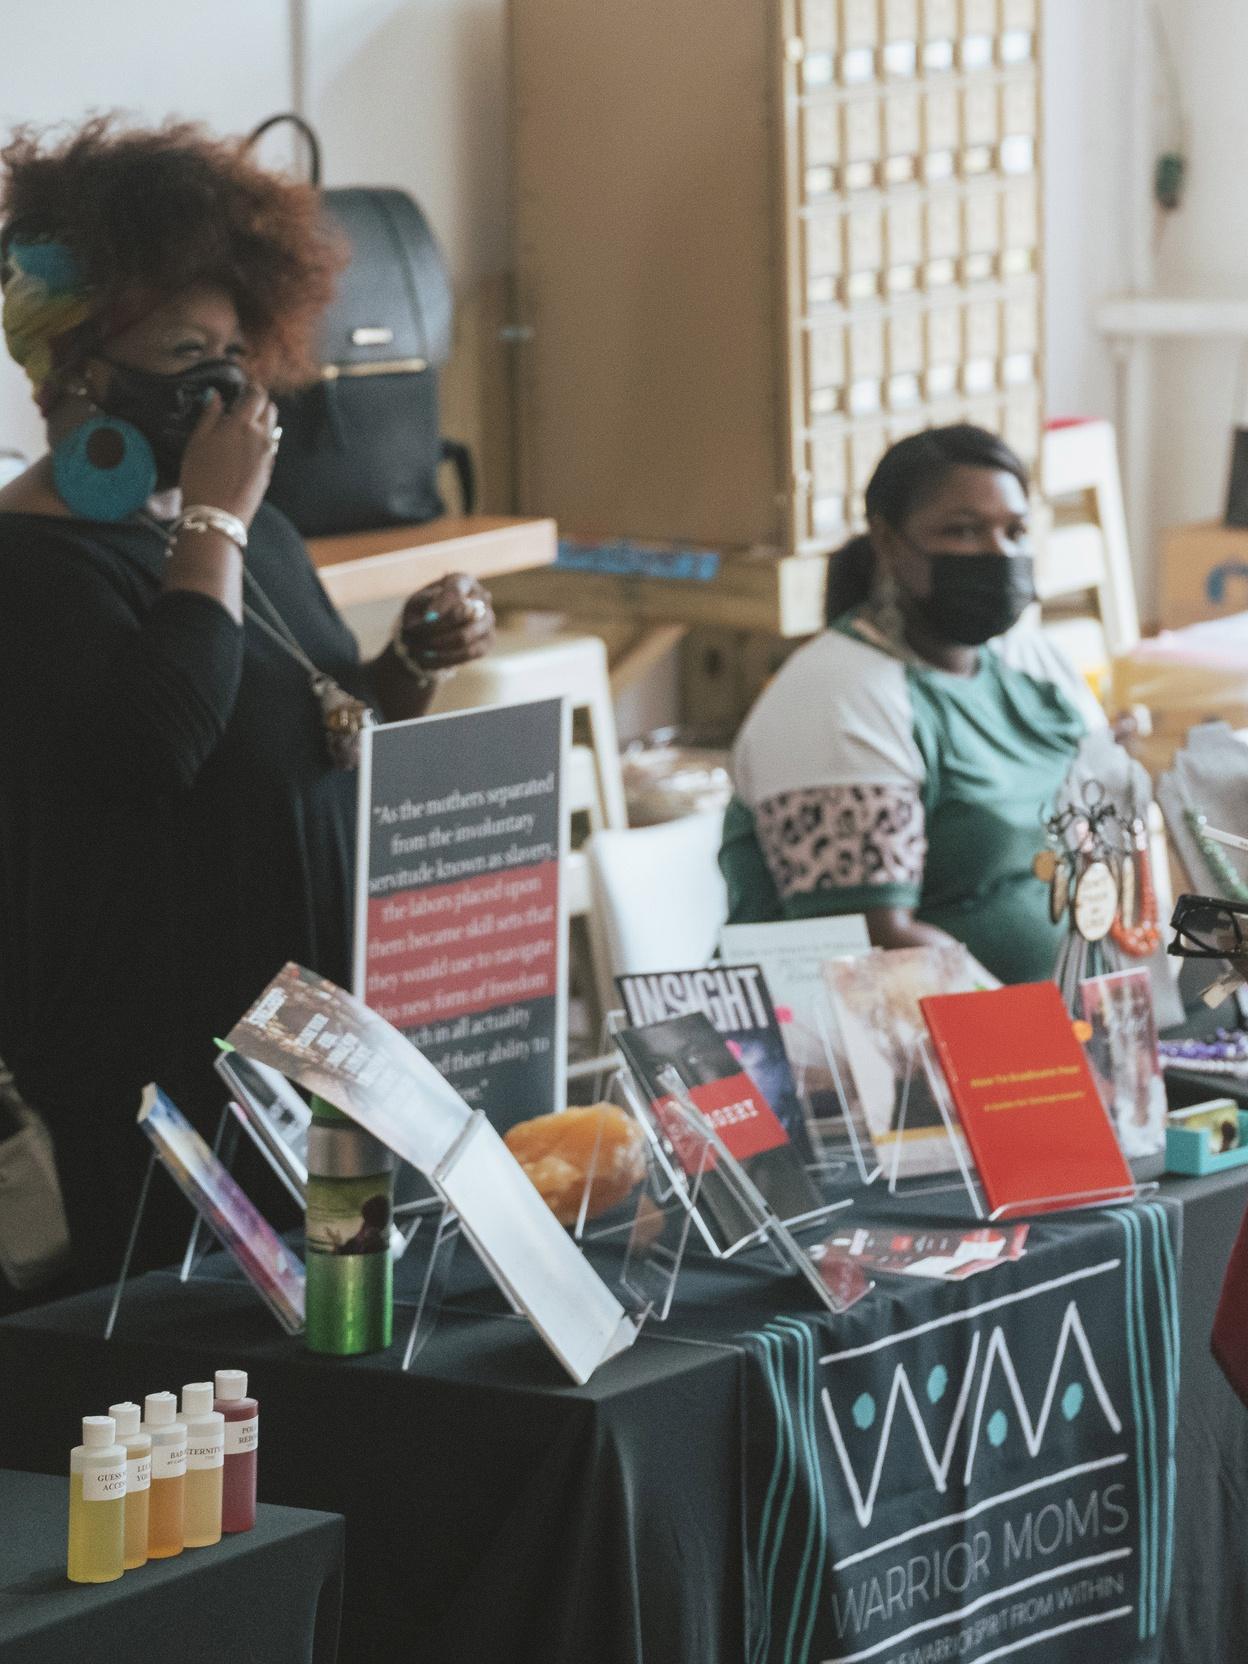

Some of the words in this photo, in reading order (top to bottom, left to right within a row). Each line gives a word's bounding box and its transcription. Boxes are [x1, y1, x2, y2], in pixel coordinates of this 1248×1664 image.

[400, 799, 424, 821] the
[425, 789, 485, 815] mothers
[486, 771, 555, 808] separated
[391, 833, 427, 855] from
[428, 826, 452, 848] the
[453, 813, 535, 844] involuntary
[367, 861, 434, 893] servitude
[435, 858, 486, 880] known
[488, 852, 503, 869] as
[381, 902, 405, 924] the
[408, 894, 451, 918] labors
[453, 878, 502, 913] placed
[503, 877, 542, 903] upon
[367, 936, 405, 958] them
[407, 925, 464, 950] became
[465, 912, 495, 938] skill
[496, 913, 524, 930] sets
[526, 904, 555, 924] that
[367, 972, 399, 994] they
[402, 954, 449, 983] would
[450, 957, 474, 974] use
[477, 951, 493, 969] to
[494, 939, 555, 965] navigate
[401, 999, 432, 1017] new
[434, 989, 466, 1008] form
[471, 982, 487, 1001] of
[487, 971, 548, 994] freedom
[621, 969, 770, 1033] INSIGHT
[434, 1025, 451, 1044] in
[452, 1016, 470, 1039] all
[471, 1007, 530, 1031] actuality
[451, 1050, 486, 1072] their
[487, 1038, 530, 1063] ability
[531, 1036, 550, 1053] to
[831, 1530, 992, 1640] WARRIOR
[1003, 1483, 1130, 1569] MOMS
[1055, 1572, 1124, 1611] WITHIN
